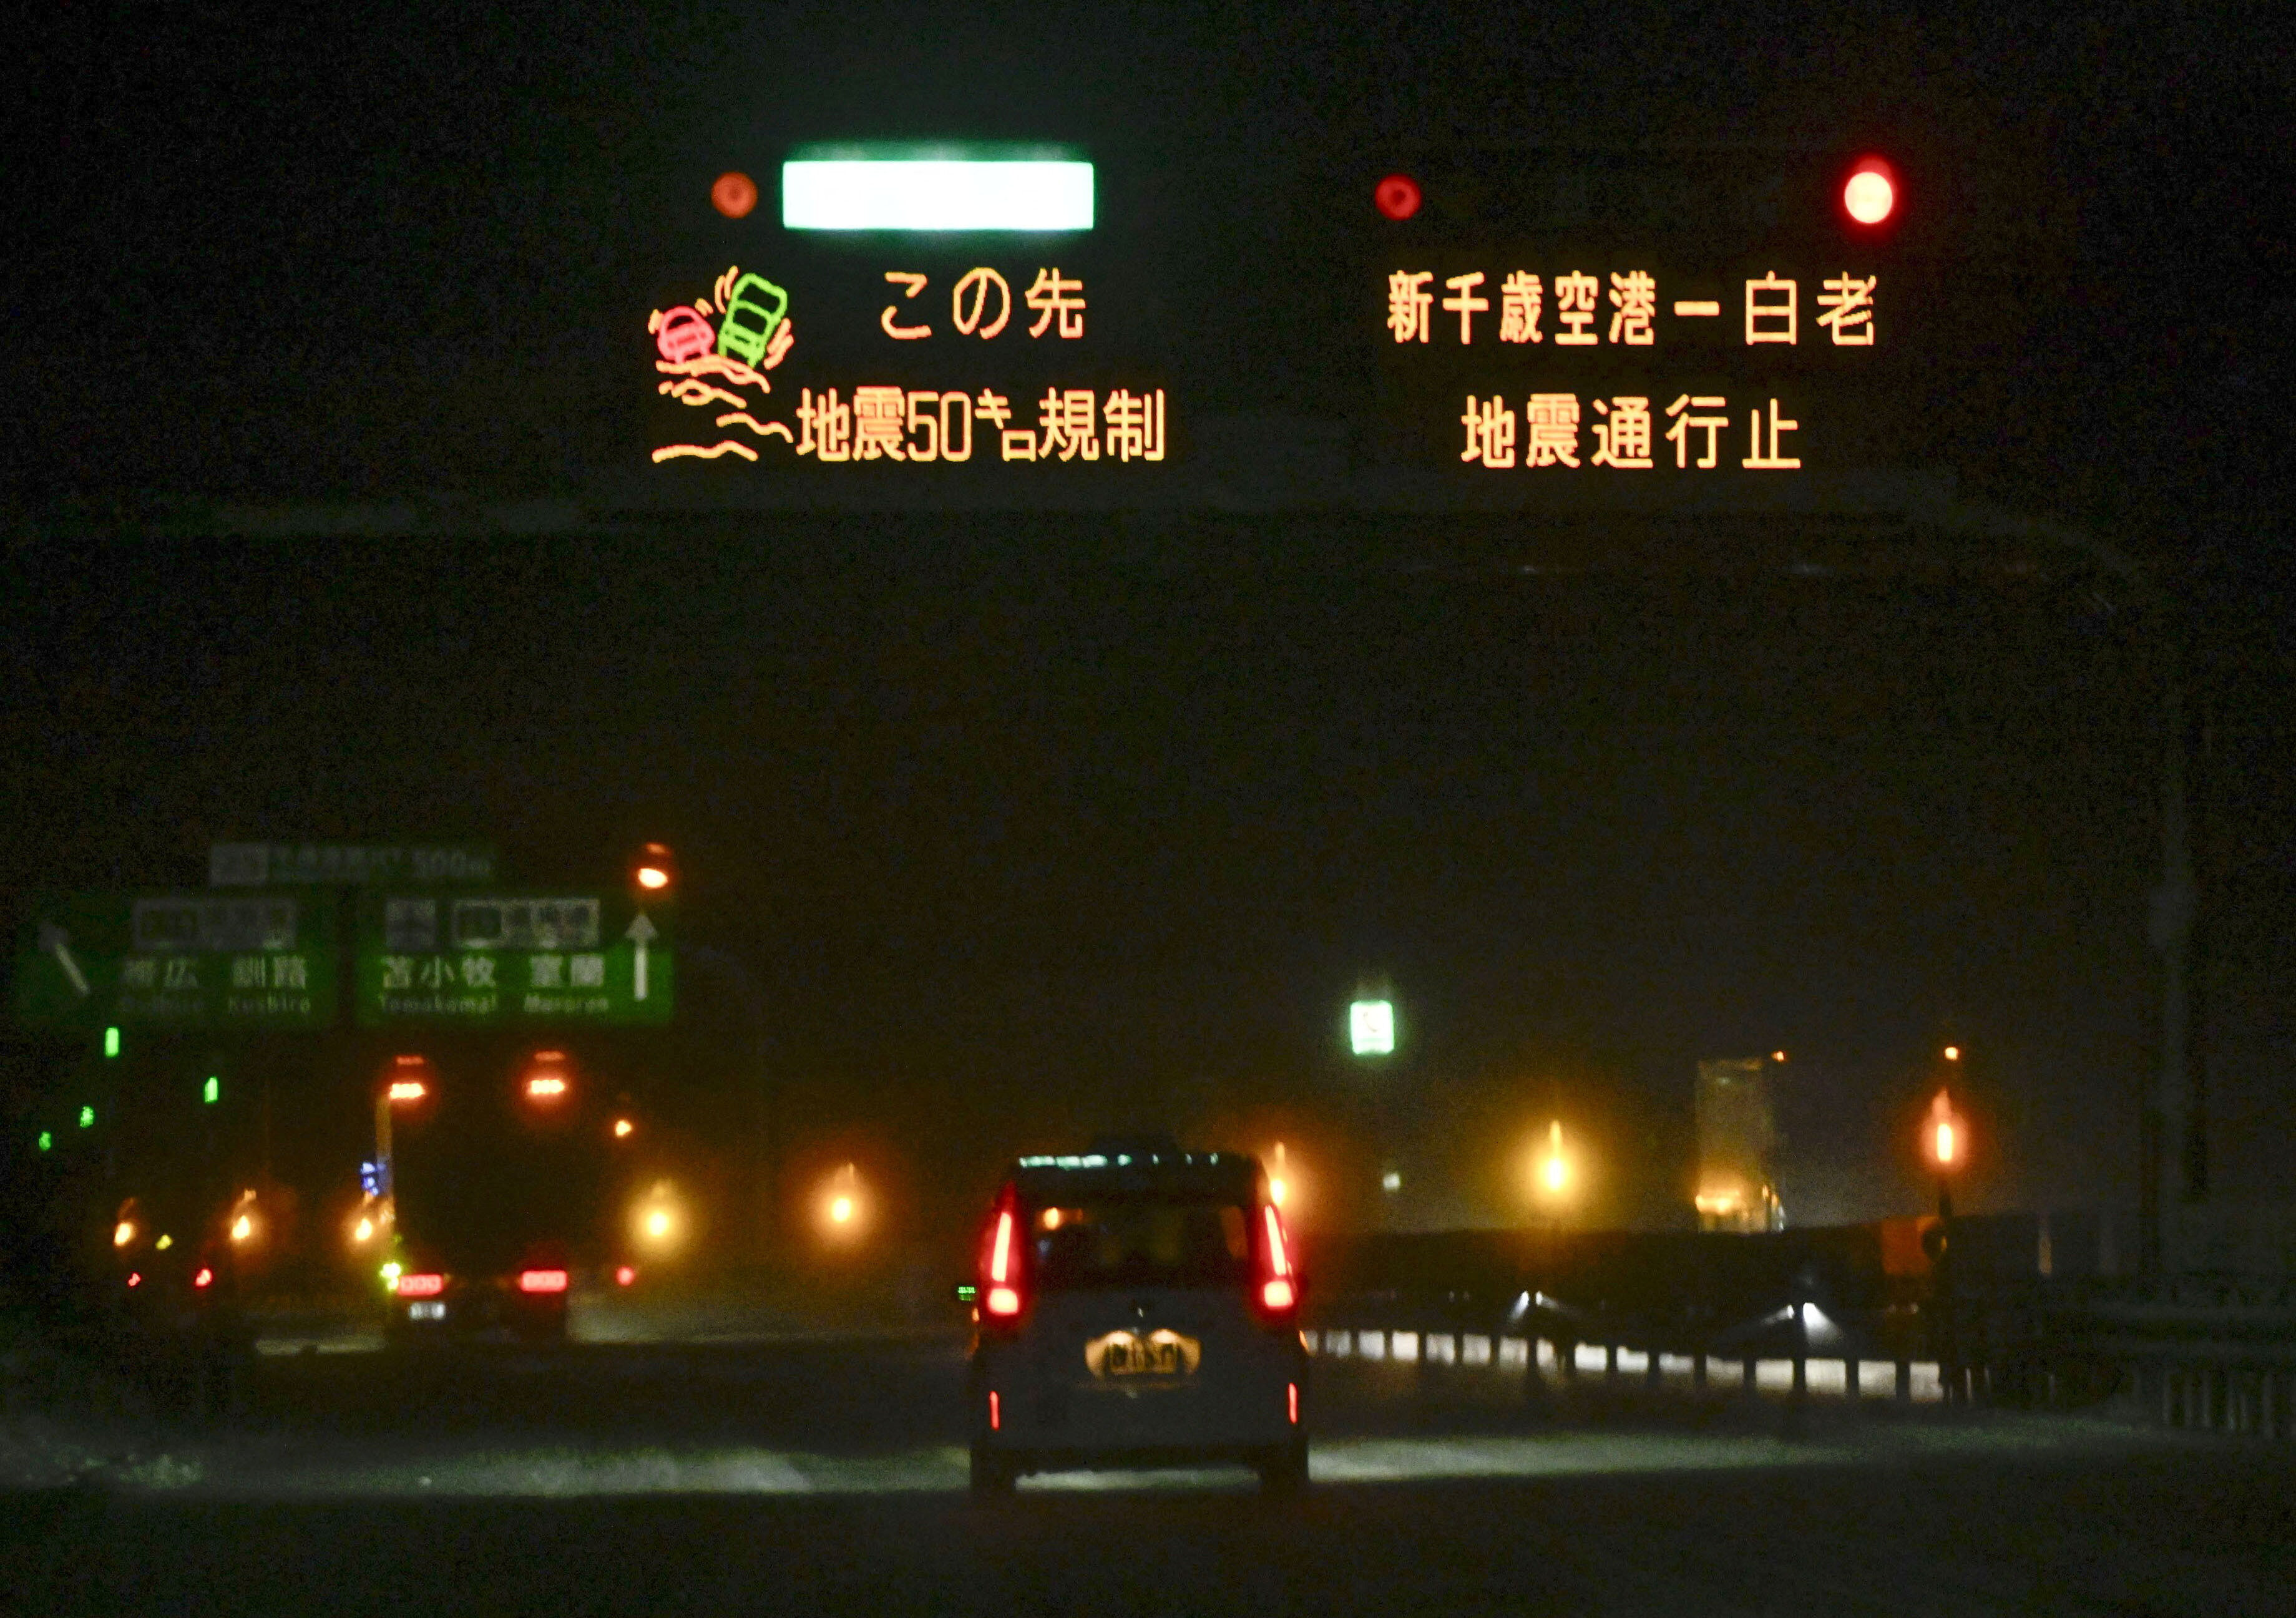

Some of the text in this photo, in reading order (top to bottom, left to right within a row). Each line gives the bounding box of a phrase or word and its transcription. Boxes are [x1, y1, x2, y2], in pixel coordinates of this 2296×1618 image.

[880, 266, 1087, 341] この先
[1460, 392, 1802, 470] 地震通行止
